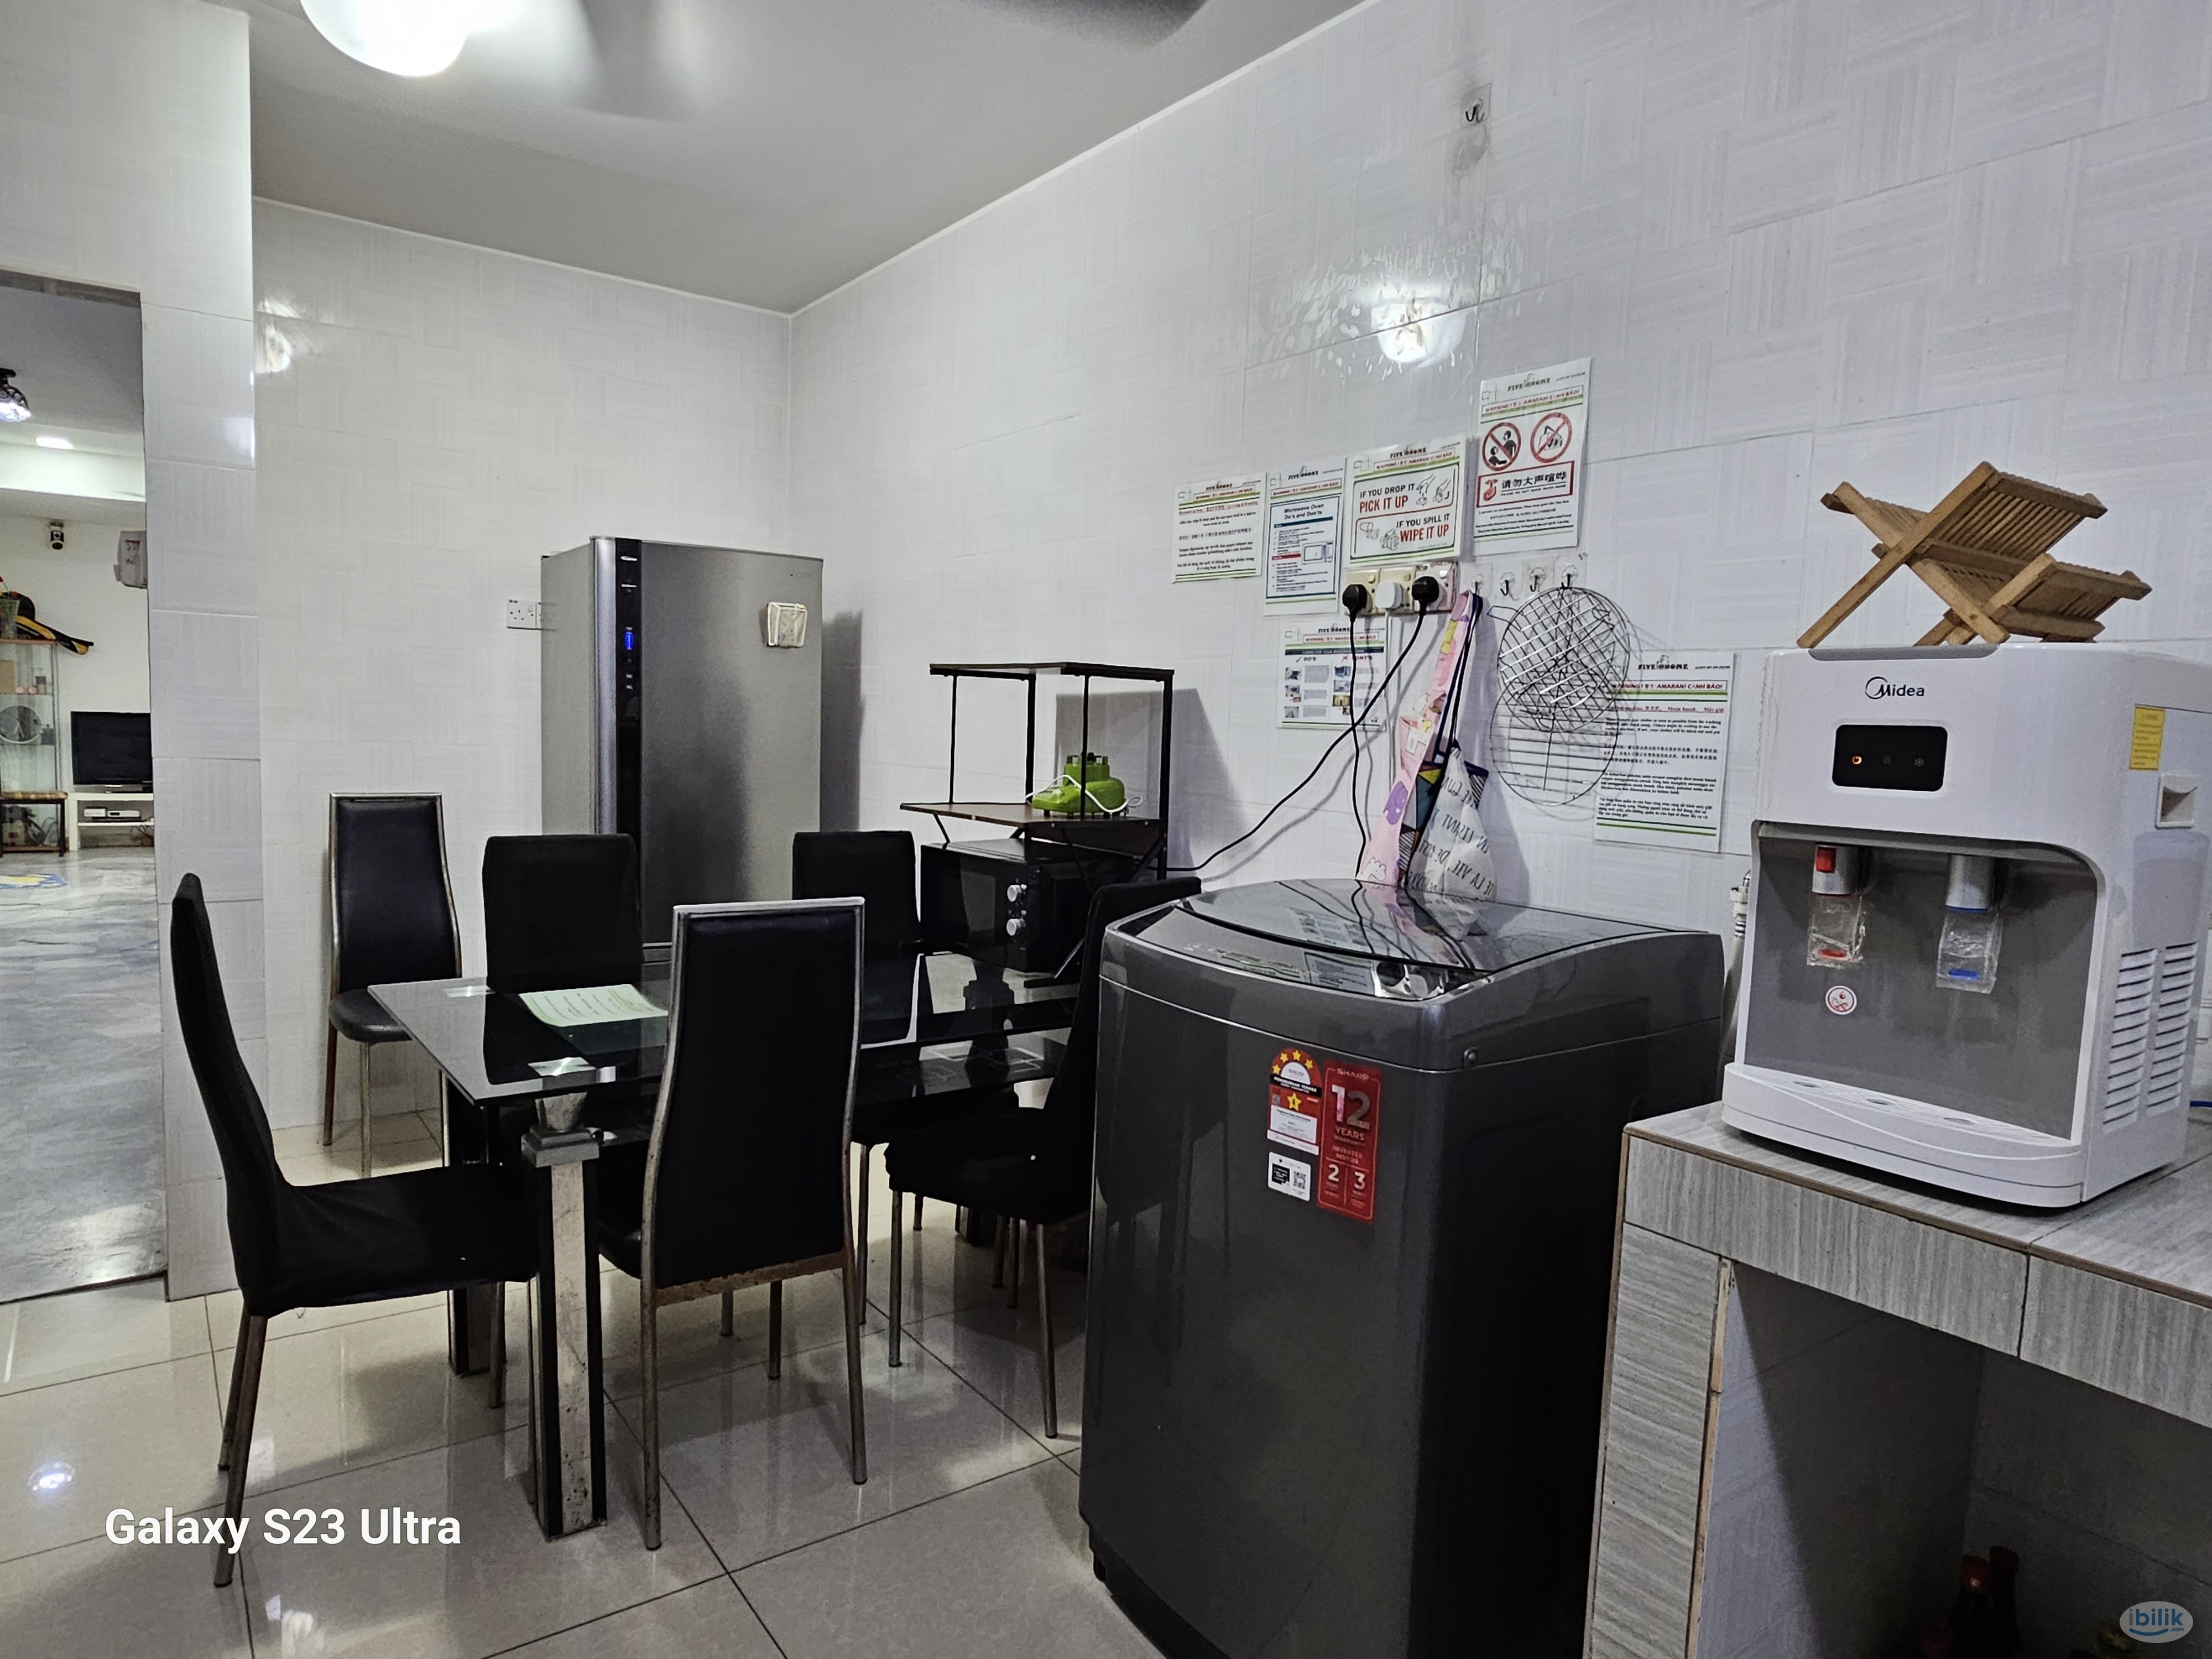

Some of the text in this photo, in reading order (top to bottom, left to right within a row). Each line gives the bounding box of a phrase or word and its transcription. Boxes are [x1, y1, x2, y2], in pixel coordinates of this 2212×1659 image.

[1502, 471, 1567, 489] 请勿大声喧哗
[1368, 488, 1383, 497] YOU
[1385, 485, 1406, 495] DROP
[1408, 483, 1415, 491] IT
[1359, 495, 1408, 513] PICK IT UP
[1406, 518, 1421, 527] YOU
[1423, 515, 1441, 525] SPILL
[1400, 524, 1449, 542] WIPE IT UP
[1867, 679, 1924, 698] Midea
[1337, 1067, 1369, 1081] SHARP
[1331, 1084, 1370, 1130] 12
[1335, 1126, 1365, 1140] YEARS
[1328, 1164, 1339, 1182] 2
[1354, 1171, 1365, 1190] 3
